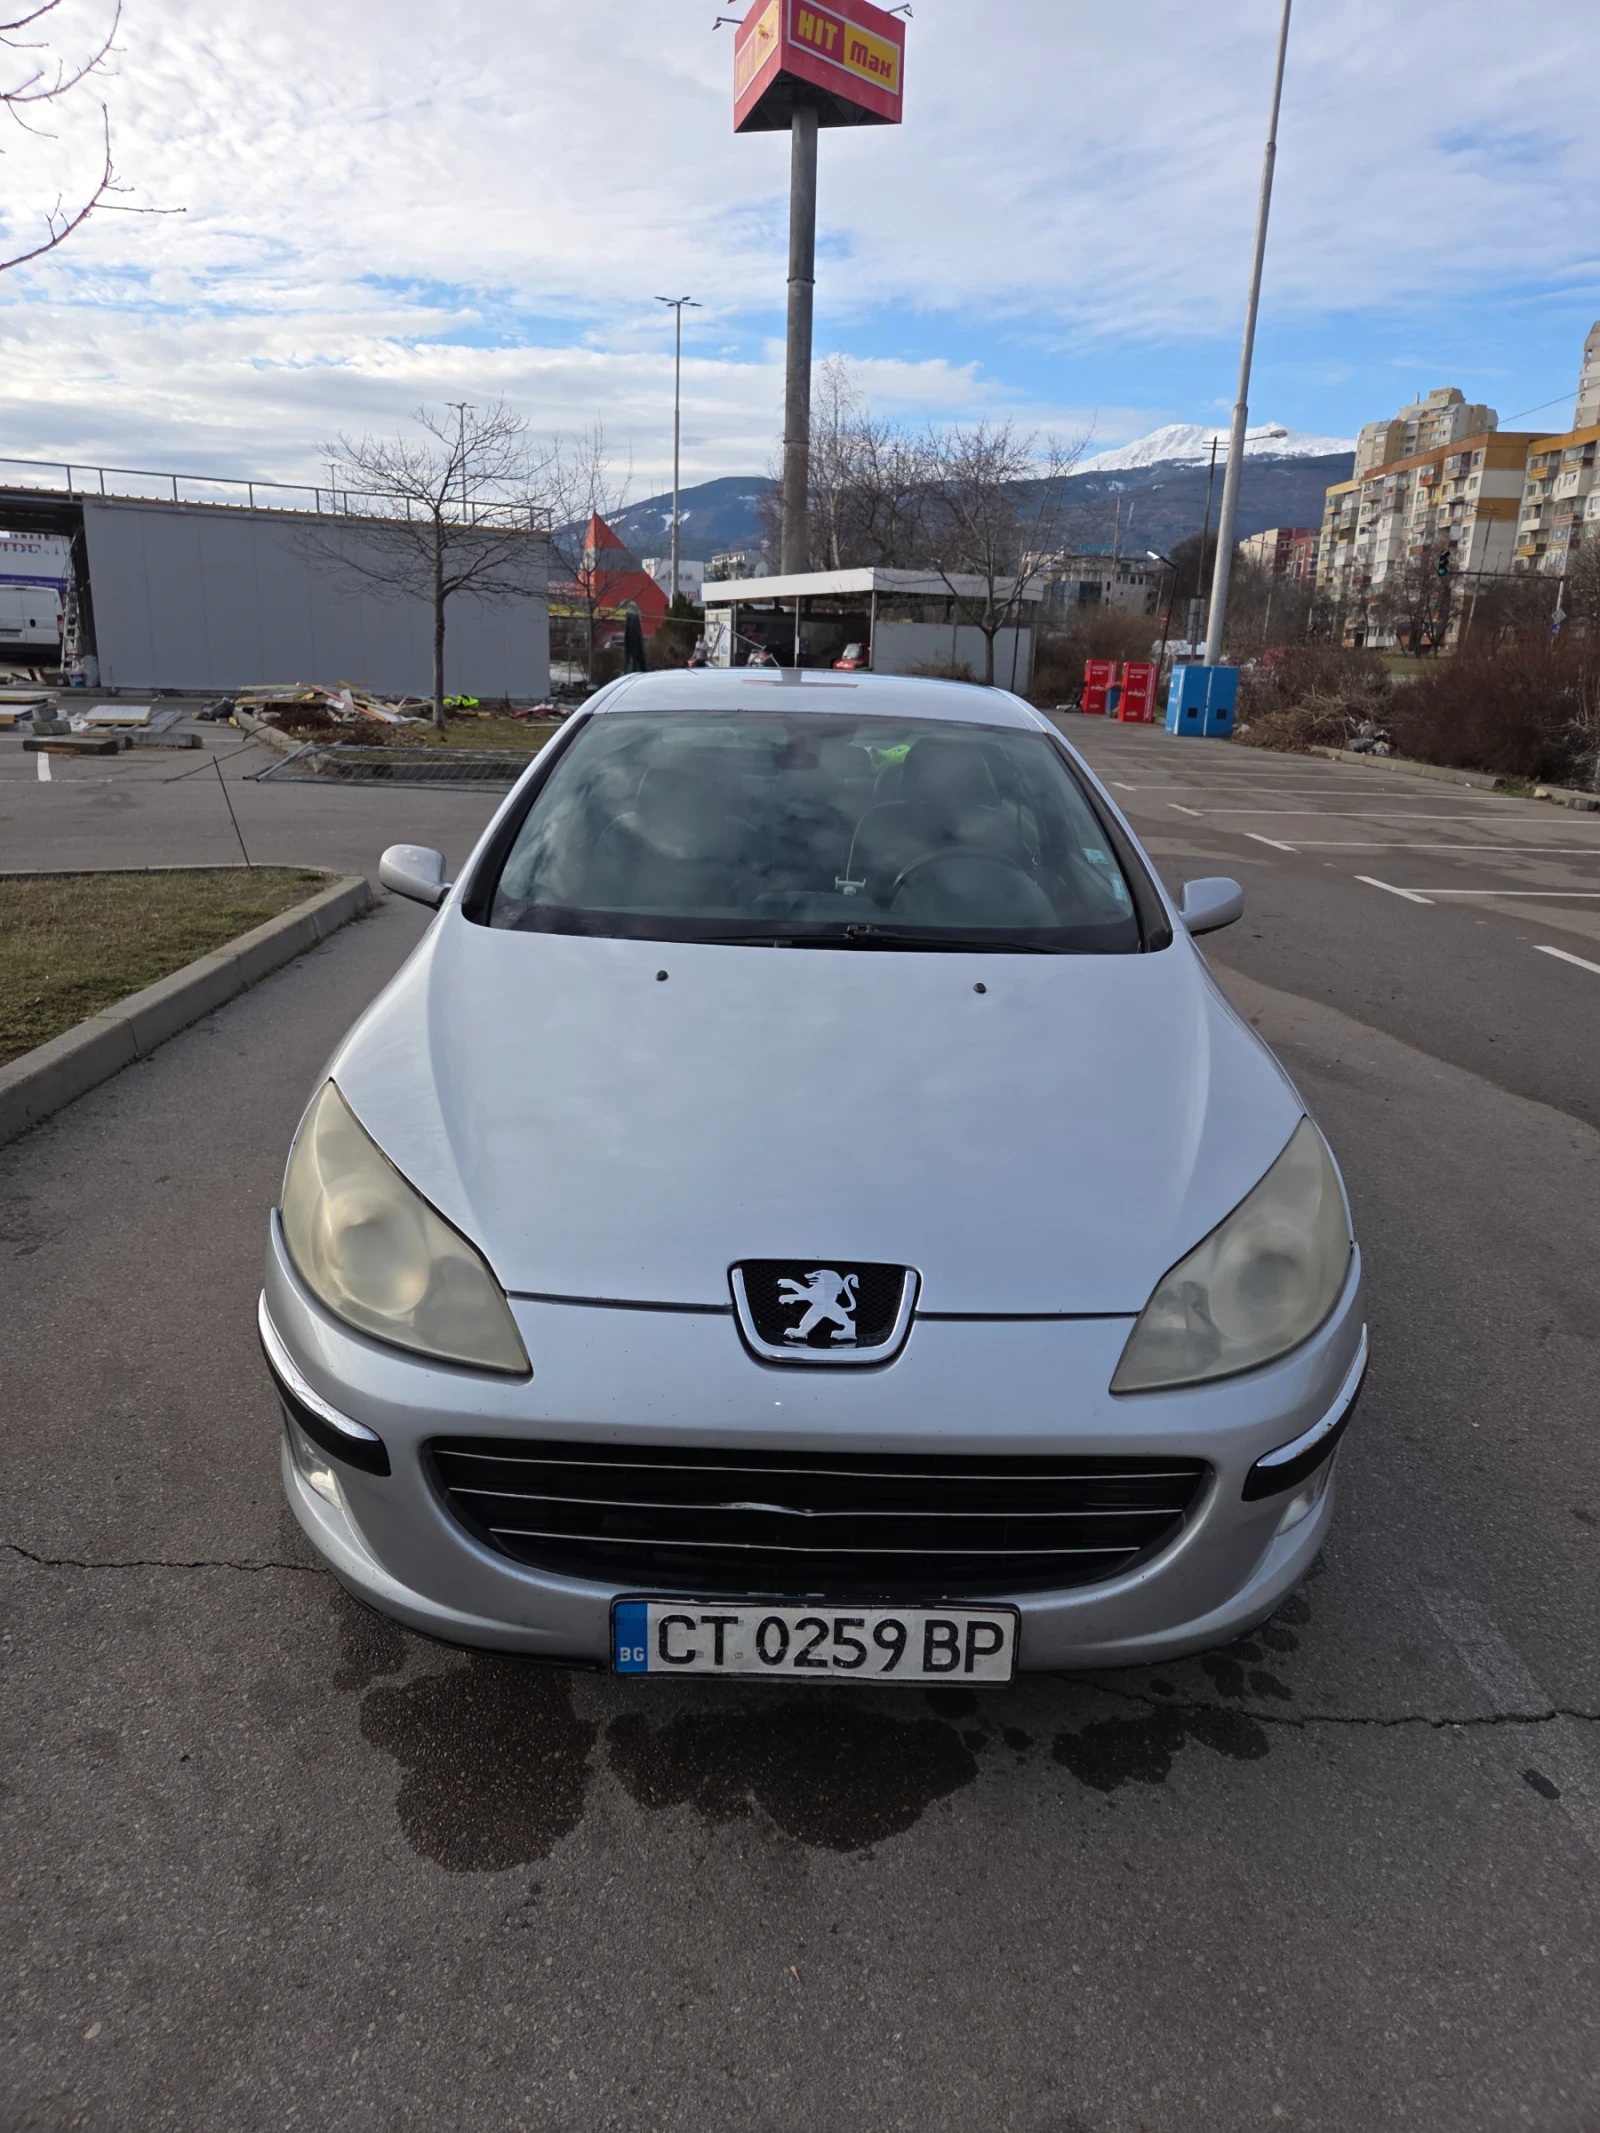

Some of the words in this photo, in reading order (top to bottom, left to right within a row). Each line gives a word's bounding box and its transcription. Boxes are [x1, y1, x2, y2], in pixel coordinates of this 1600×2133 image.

[798, 9, 839, 51] HIT
[619, 1646, 645, 1663] BG
[657, 1614, 739, 1666] CT
[755, 1615, 908, 1673] 0259
[921, 1618, 1005, 1674] BP
